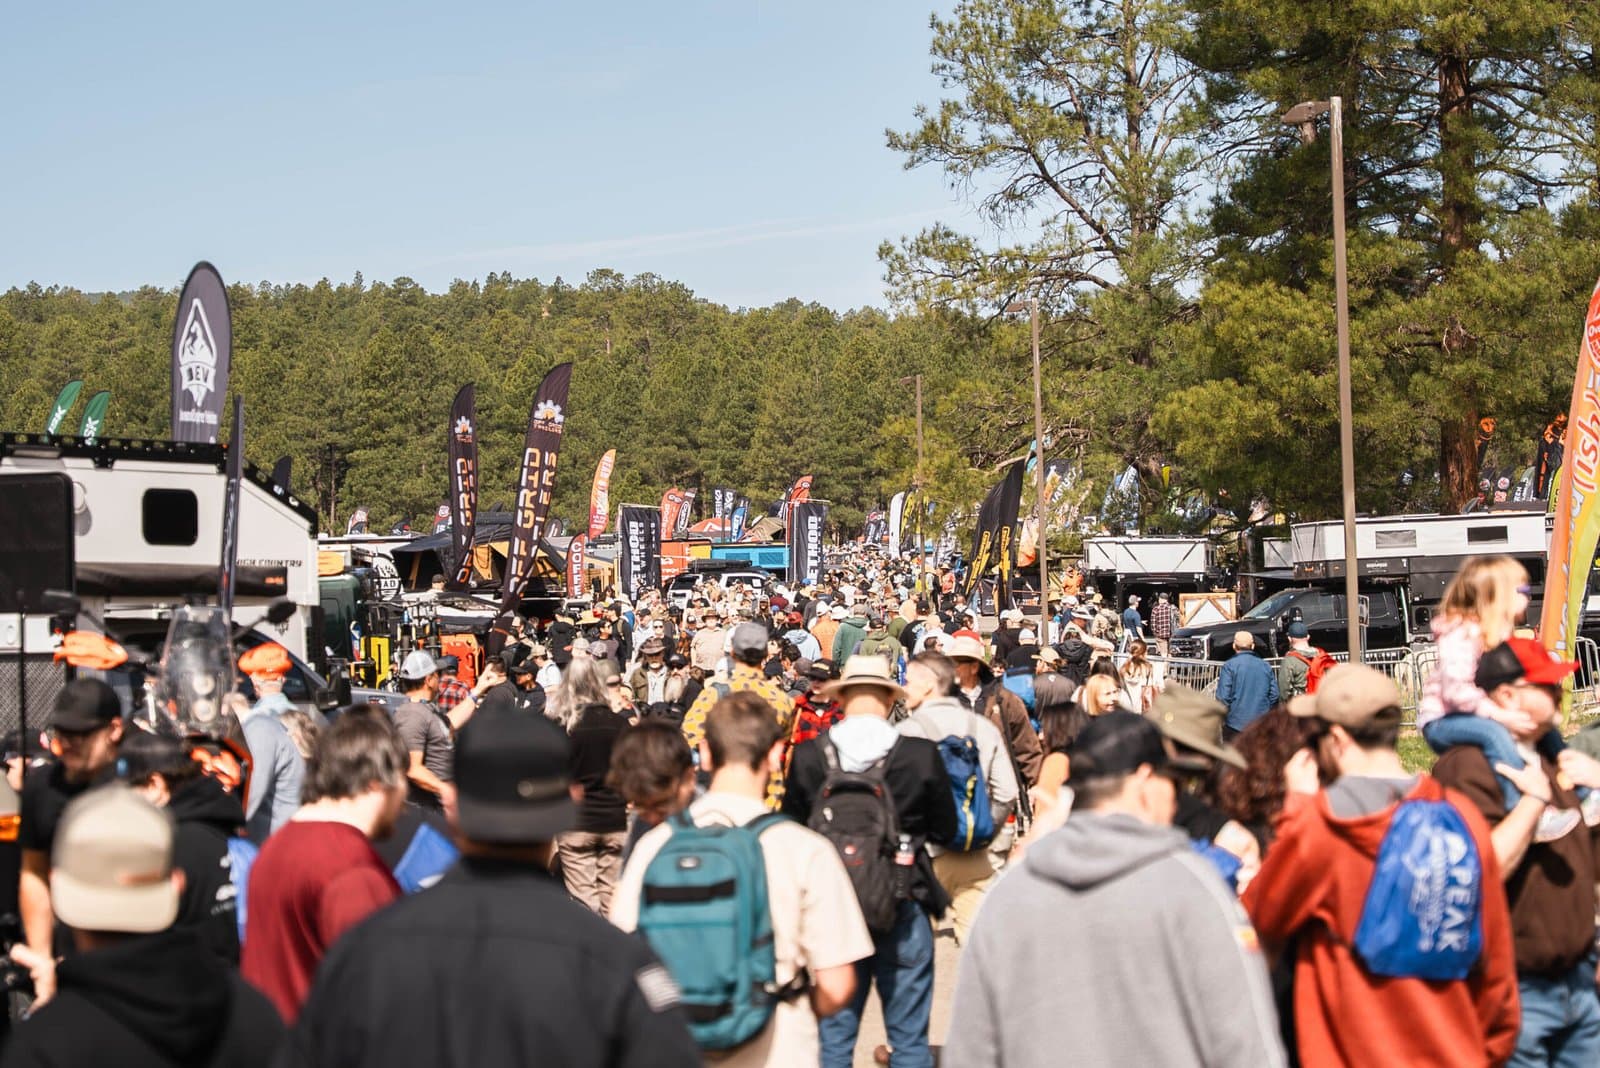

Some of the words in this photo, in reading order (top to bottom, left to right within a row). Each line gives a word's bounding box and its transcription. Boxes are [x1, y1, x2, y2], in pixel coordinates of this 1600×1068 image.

[516, 447, 541, 529] GRID
[259, 560, 303, 568] COUNTRY
[571, 542, 582, 598] COFFE
[1437, 867, 1472, 953] PEAK
